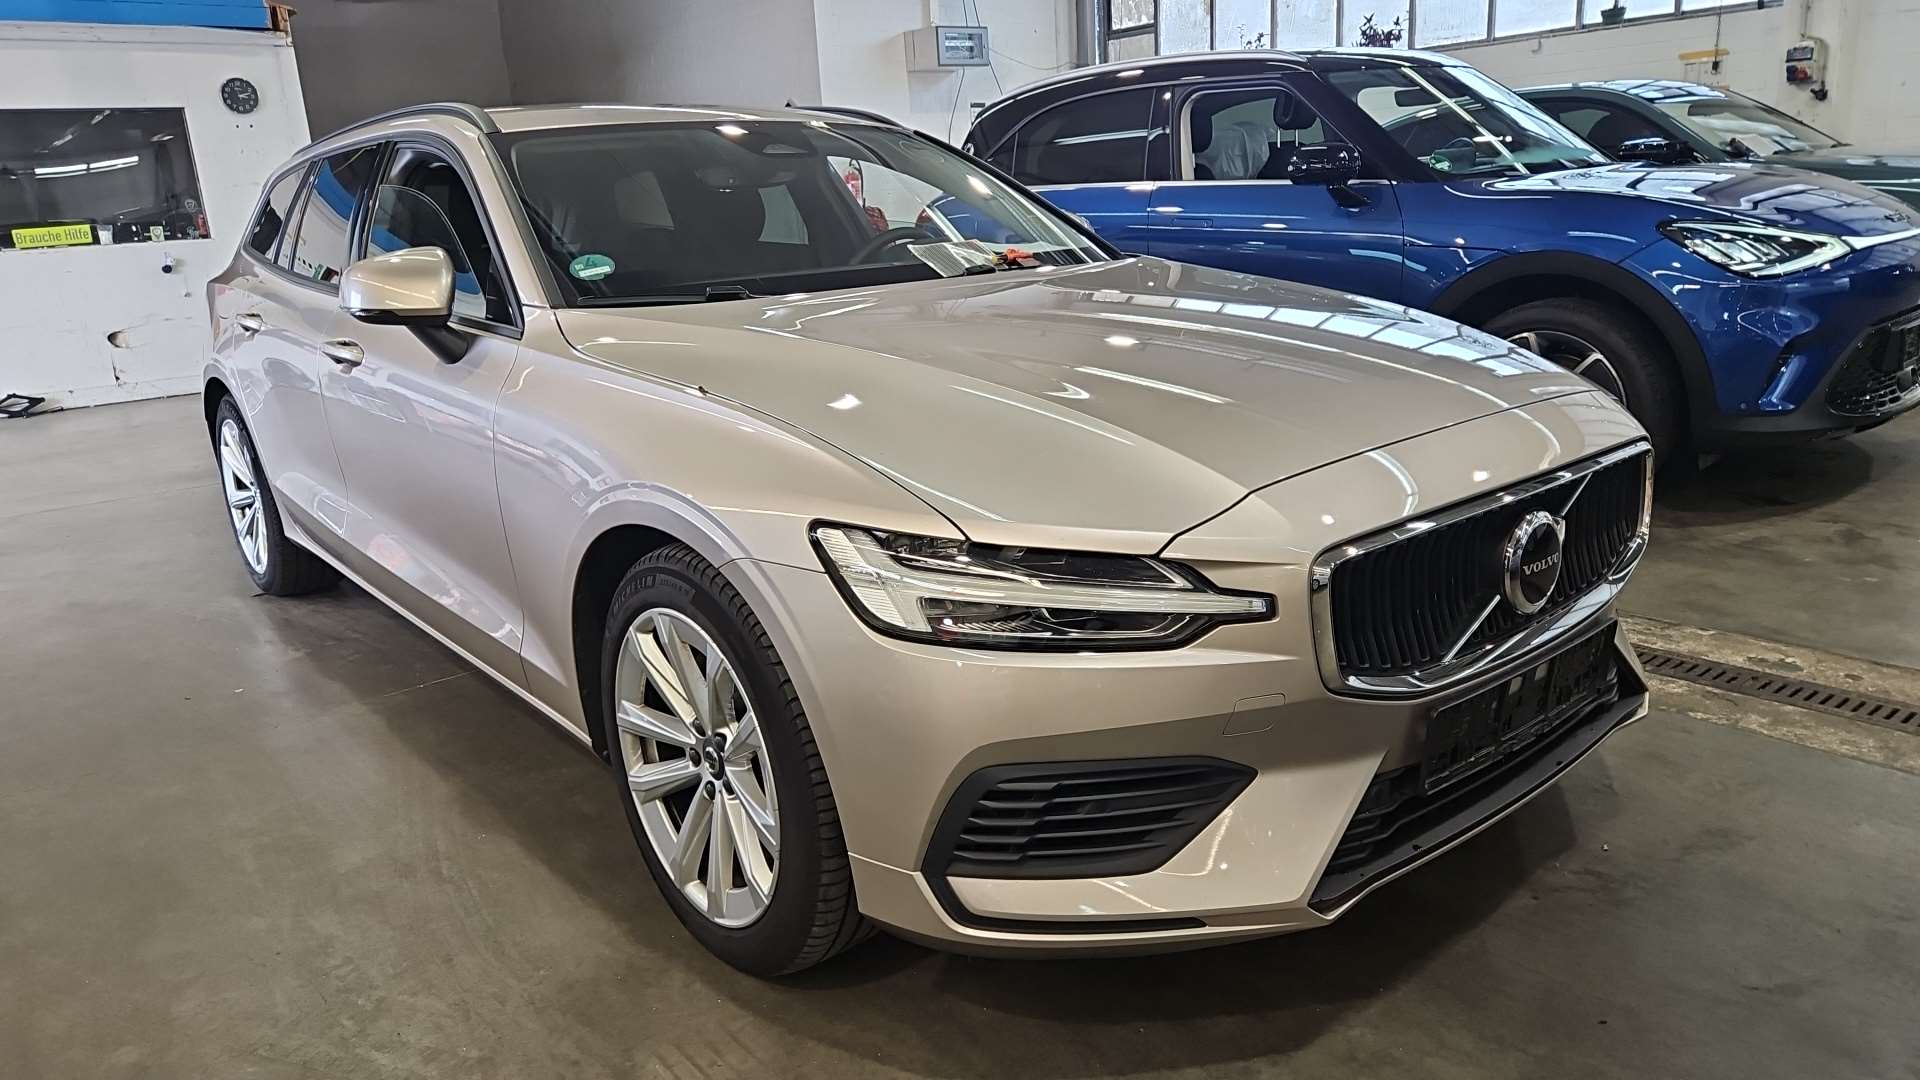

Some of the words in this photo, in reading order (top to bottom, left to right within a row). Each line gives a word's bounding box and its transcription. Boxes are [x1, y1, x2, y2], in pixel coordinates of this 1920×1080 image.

[15, 230, 62, 245] Brauche
[63, 227, 89, 241] Hilfe
[1522, 552, 1560, 576] VOLVO
